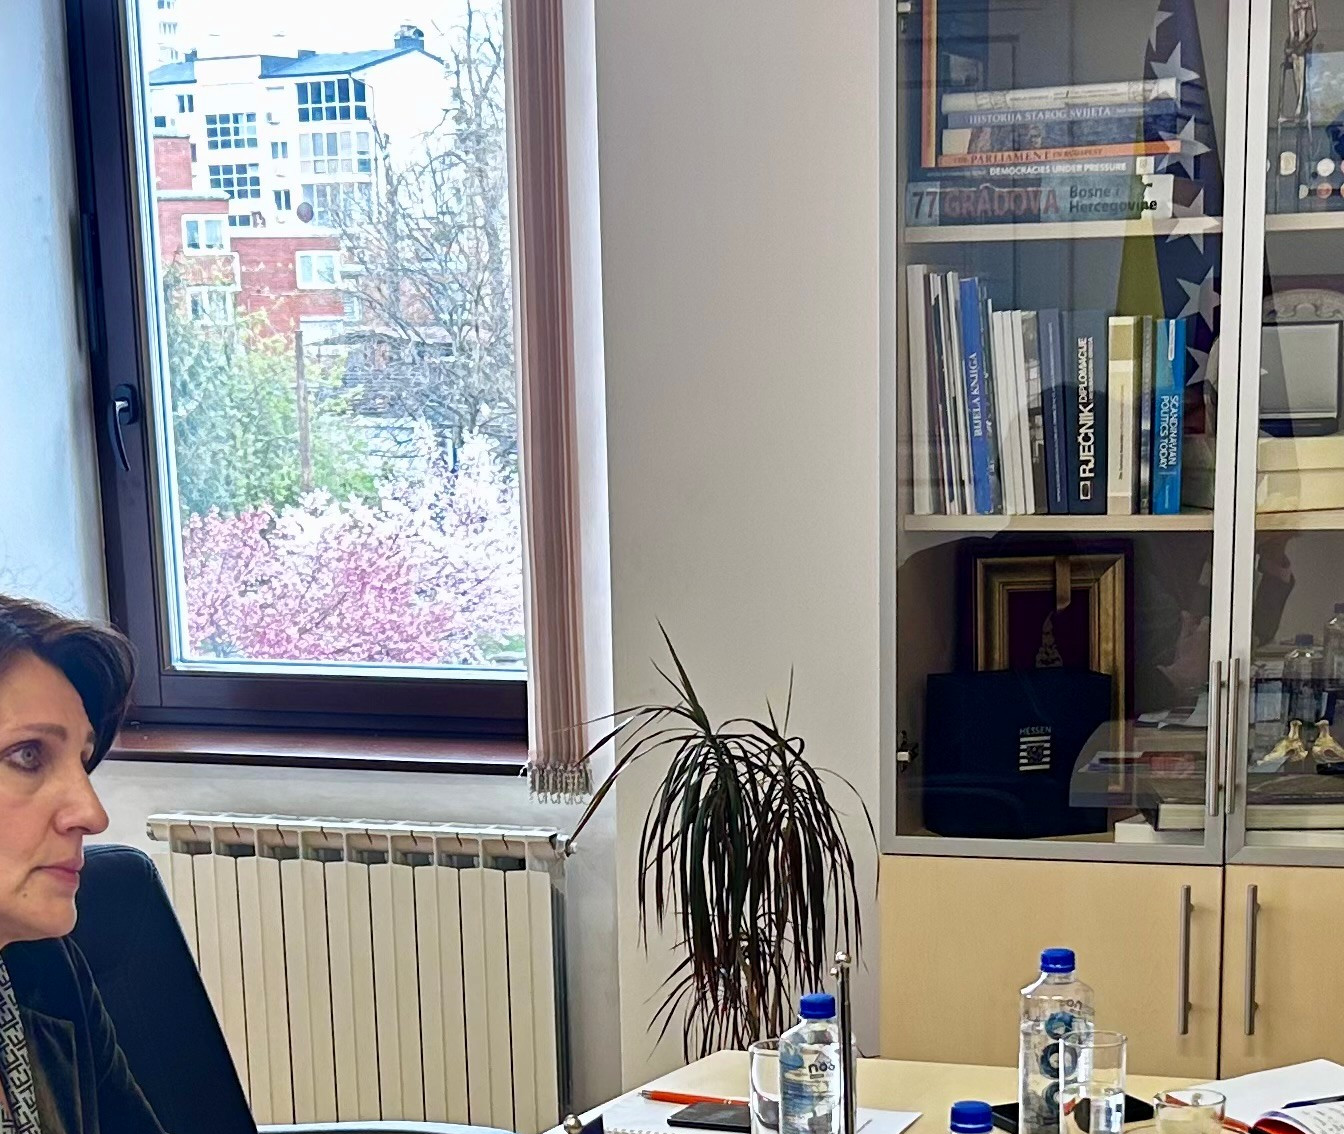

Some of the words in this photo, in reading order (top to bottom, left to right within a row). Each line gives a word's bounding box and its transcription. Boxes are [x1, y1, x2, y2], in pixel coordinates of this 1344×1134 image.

[969, 112, 1023, 124] HISTORIJA
[1025, 109, 1067, 121] STAROG
[1069, 107, 1111, 119] SVIJETA
[970, 151, 1050, 164] PARLIAMENT
[989, 164, 1050, 175] DEMOCRACIES
[1052, 163, 1083, 174] UNDER
[1083, 162, 1127, 173] PRESSURE
[911, 189, 940, 220] 77
[1069, 185, 1106, 199] Bosne
[968, 352, 982, 395] KNJIGA
[1077, 337, 1089, 403] DIPLOMACIJE
[971, 395, 983, 438] BIJELA
[1160, 395, 1170, 436] POLITICS
[1167, 395, 1179, 466] SCANDINAVIAN
[1077, 403, 1095, 478] RJEČNIK
[1158, 436, 1168, 470] TODAY
[1019, 726, 1052, 735] HESSEN
